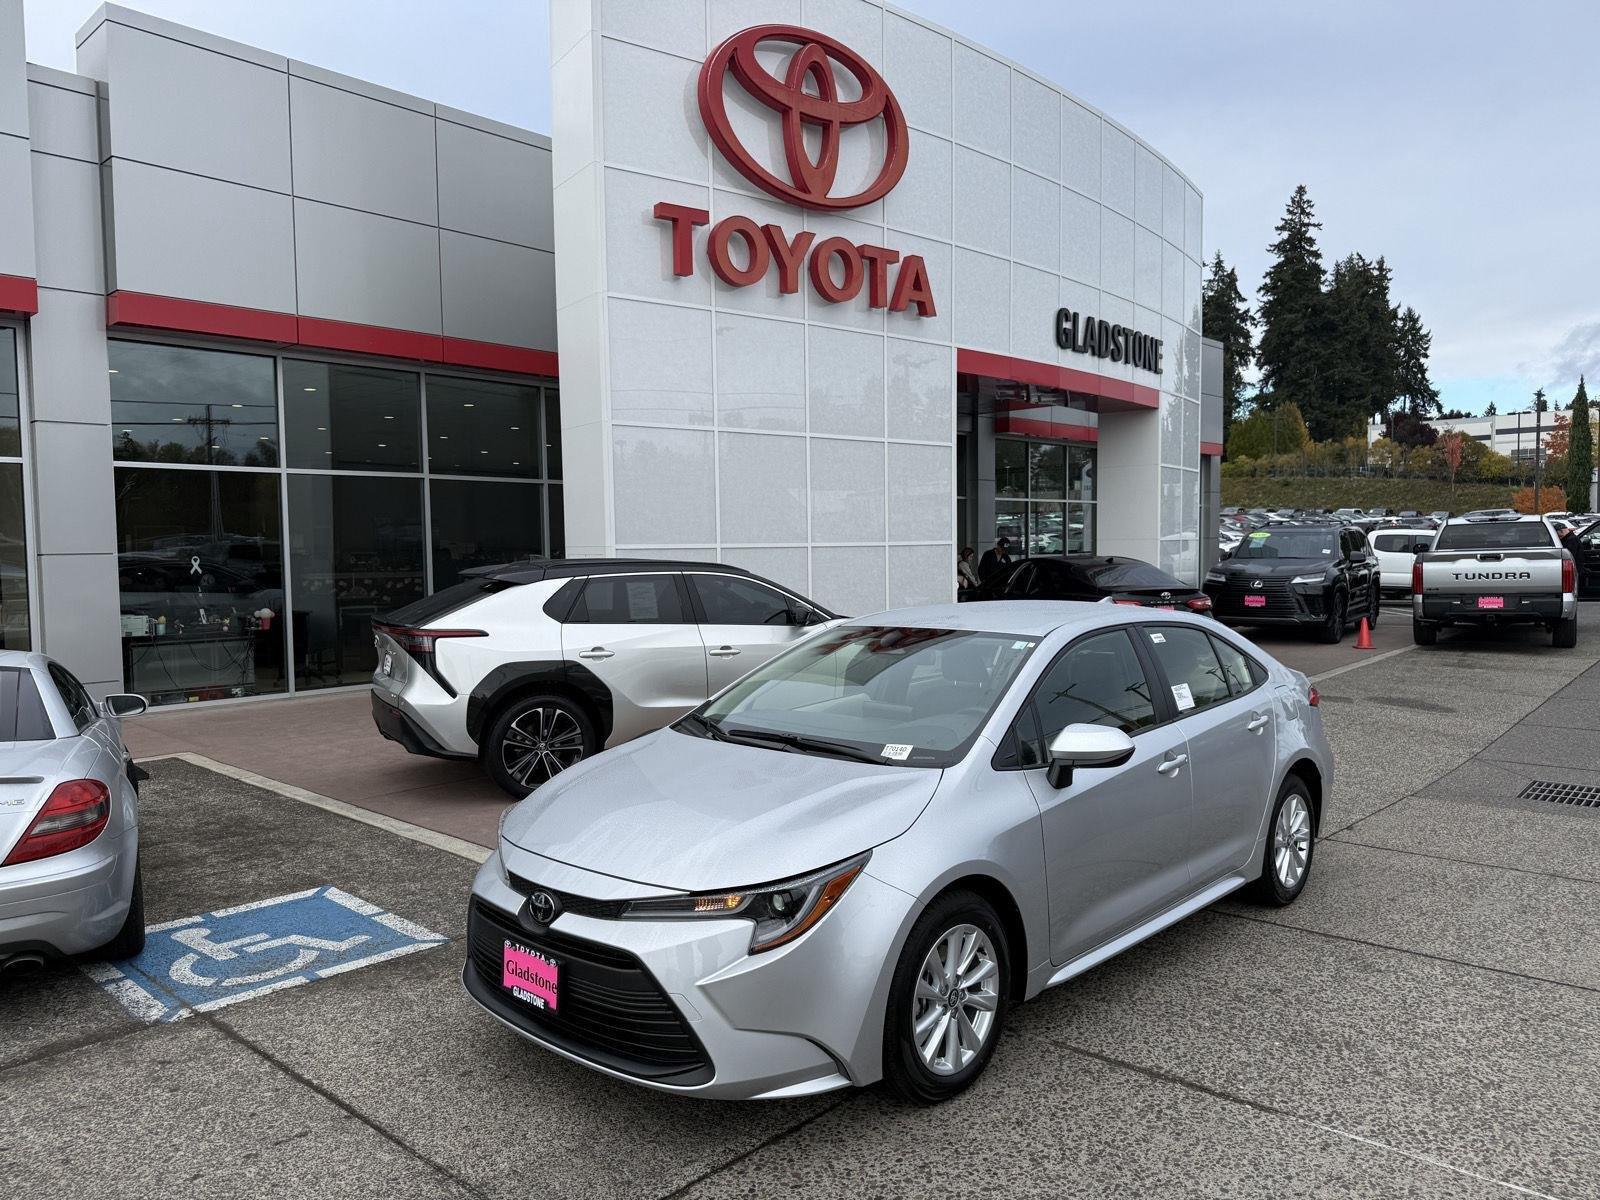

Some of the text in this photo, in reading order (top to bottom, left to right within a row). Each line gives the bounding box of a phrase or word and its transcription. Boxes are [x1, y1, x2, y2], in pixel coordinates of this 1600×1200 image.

[654, 202, 937, 317] TOYOTA
[1056, 307, 1163, 374] GLADSTONE
[1452, 572, 1531, 580] TUNDRA
[515, 944, 546, 961] TOYOTA
[506, 959, 558, 995] Gladstone
[512, 986, 545, 1009] GLADSTONE
